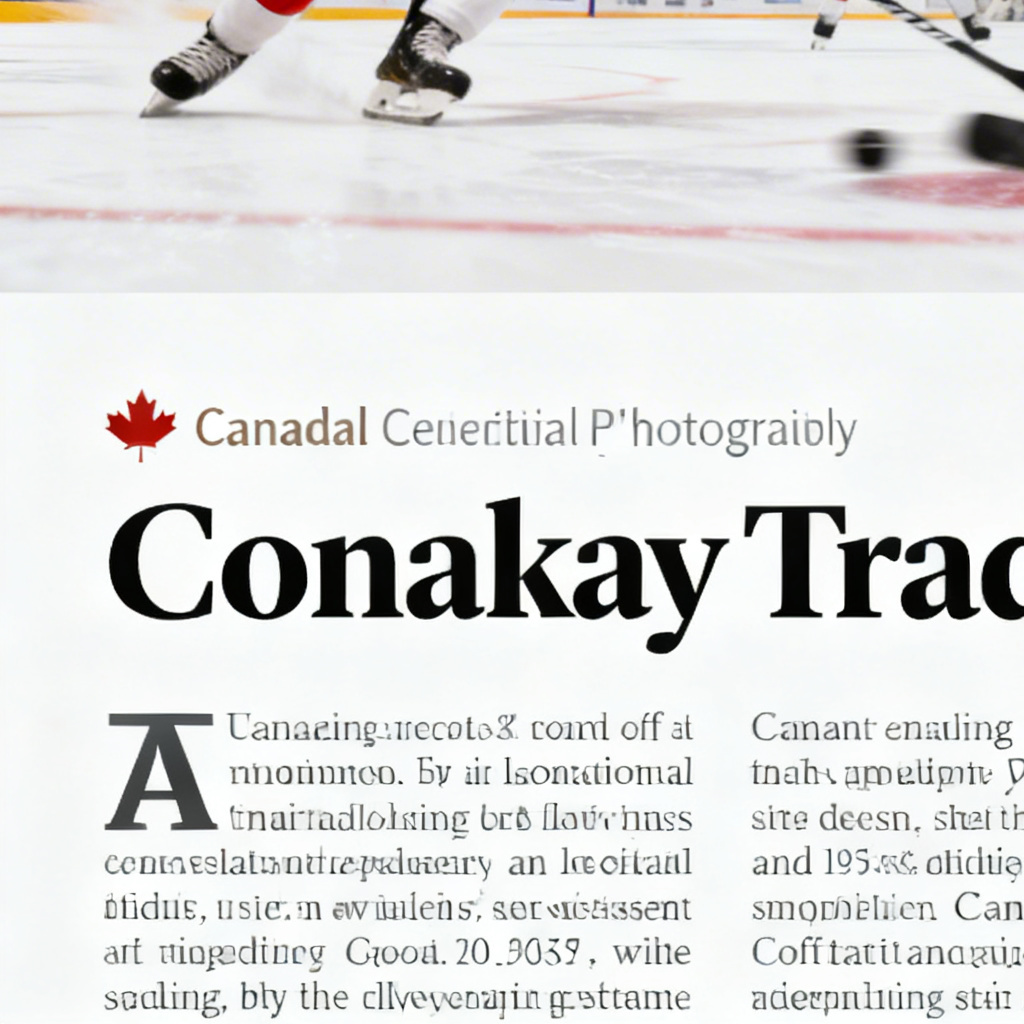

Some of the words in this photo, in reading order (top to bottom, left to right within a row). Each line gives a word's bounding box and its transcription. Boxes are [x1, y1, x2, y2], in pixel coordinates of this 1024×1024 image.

[196, 406, 368, 446] Canadal
[108, 496, 730, 655] Conakay
[621, 711, 664, 741] off
[671, 715, 693, 740] at
[104, 713, 218, 831] A
[509, 856, 546, 875] an
[753, 846, 812, 875] and
[300, 981, 348, 1010] the
